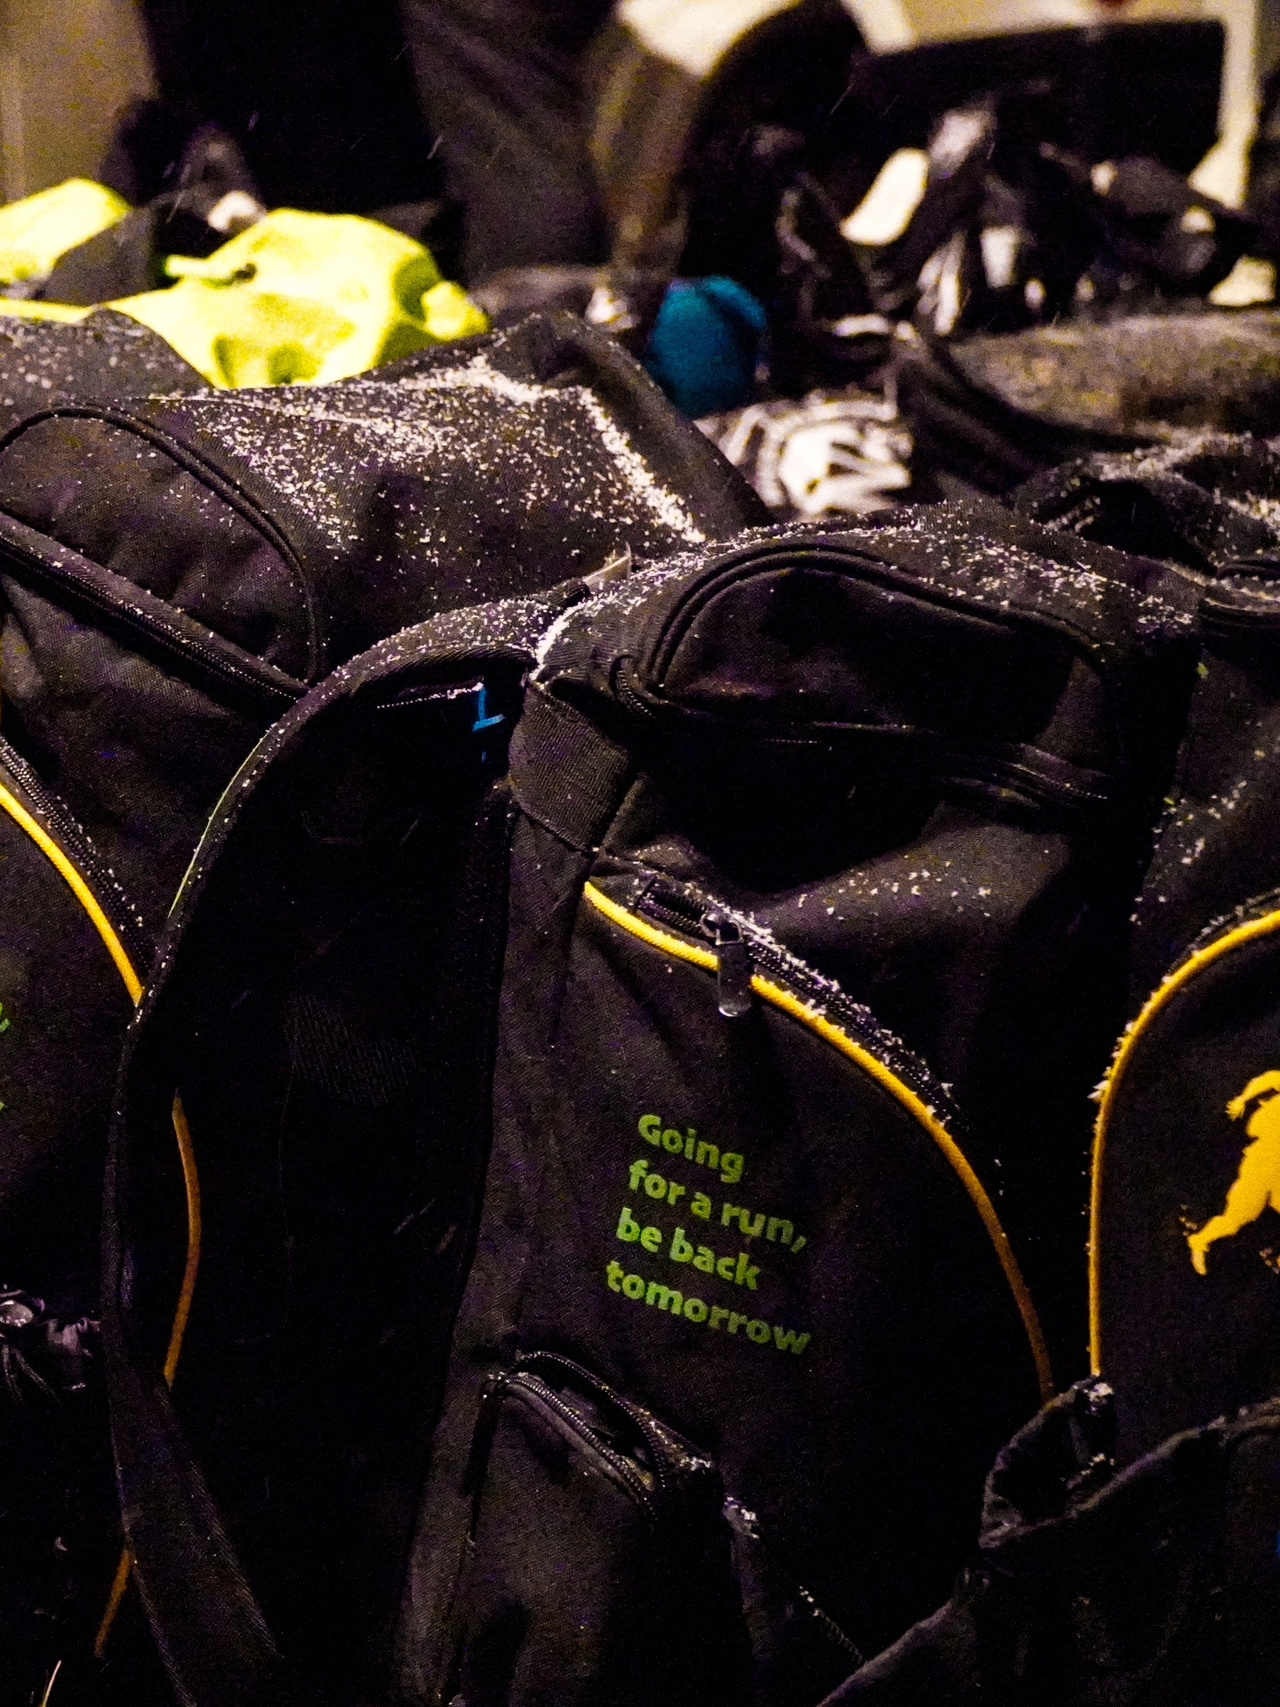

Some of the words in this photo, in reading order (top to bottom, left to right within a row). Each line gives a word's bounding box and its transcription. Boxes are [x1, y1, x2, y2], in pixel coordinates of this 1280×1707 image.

[638, 1114, 744, 1183] Going
[616, 1207, 662, 1253] be
[670, 1227, 761, 1290] back
[629, 1160, 686, 1205] for
[691, 1192, 712, 1221] a
[721, 1203, 807, 1254] run,
[606, 1260, 811, 1355] tomorrow
